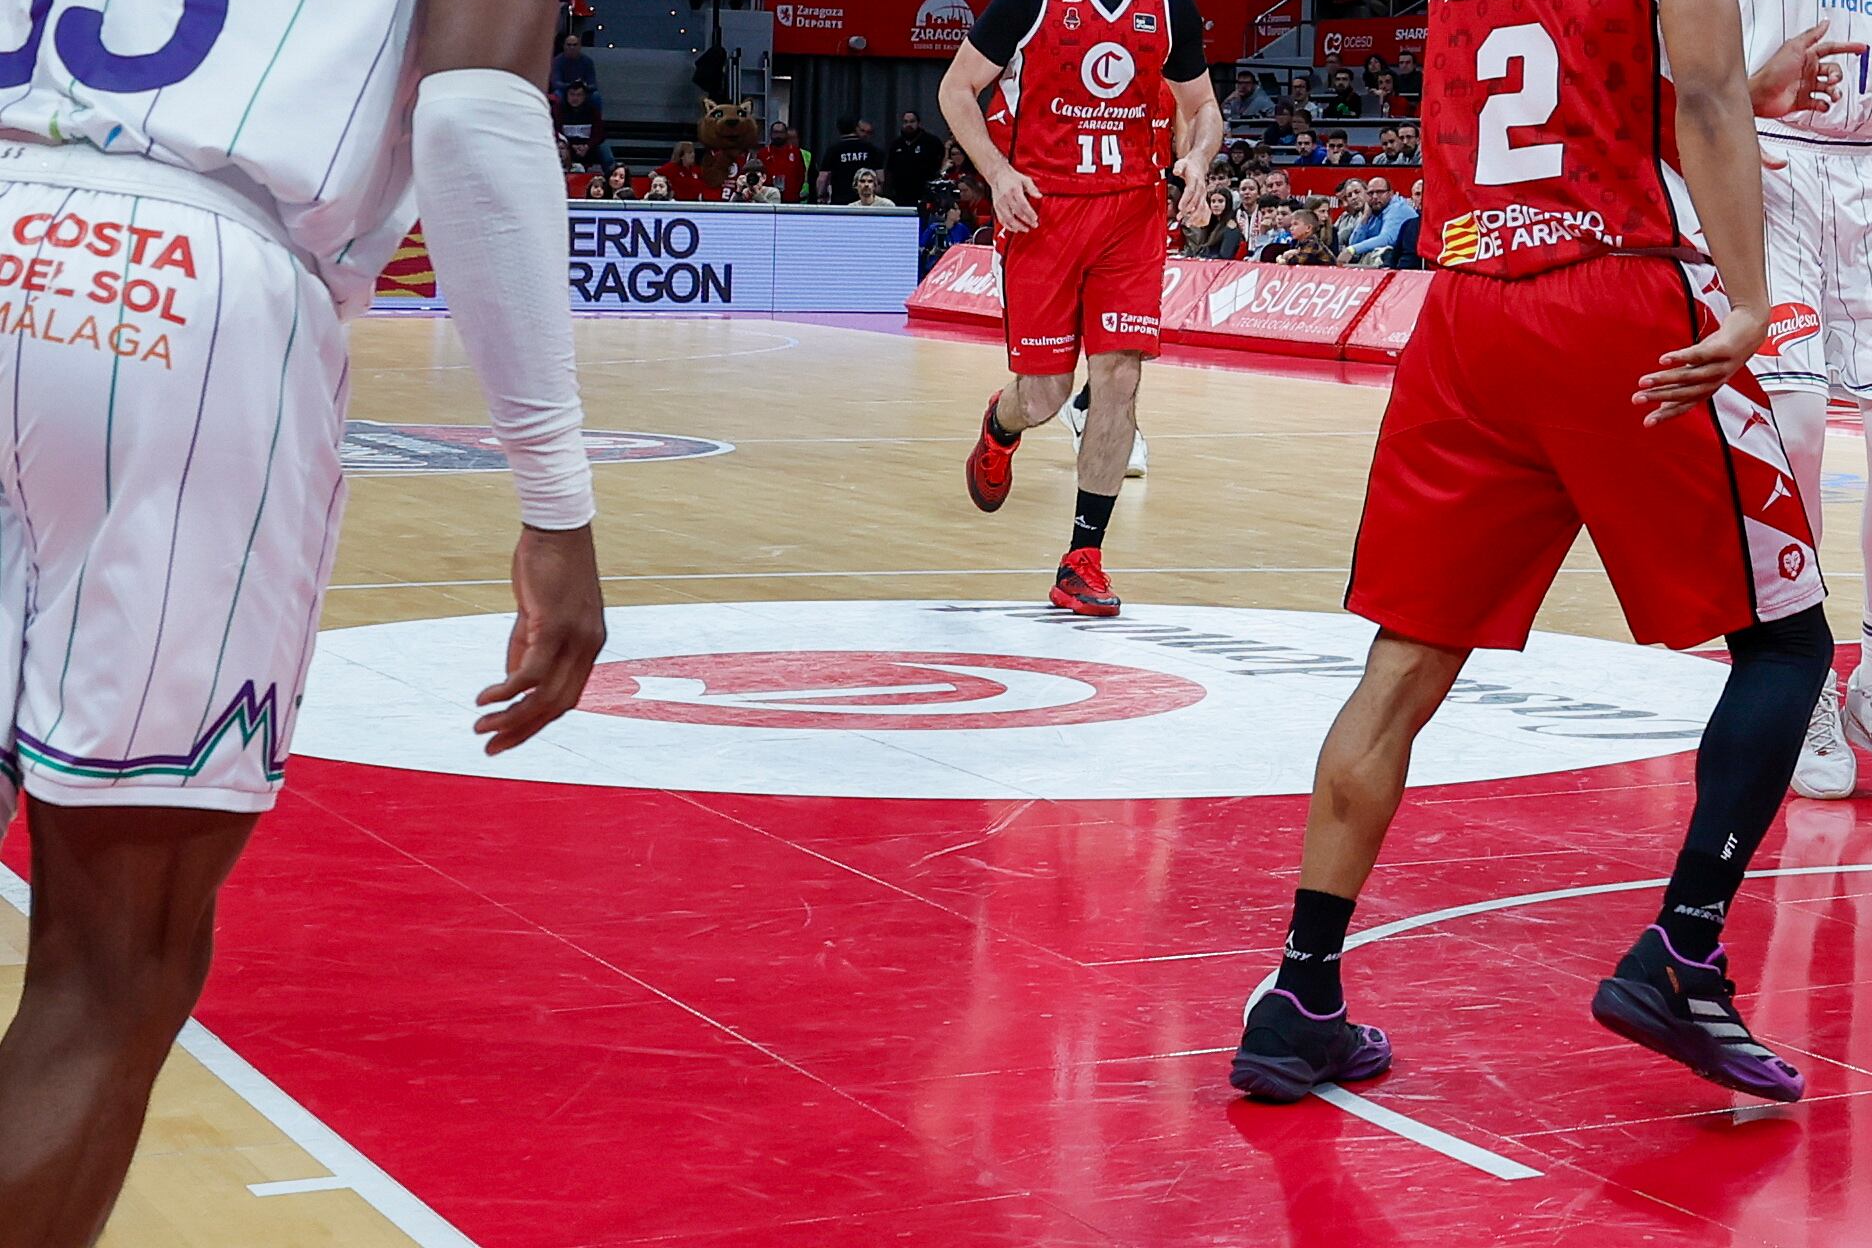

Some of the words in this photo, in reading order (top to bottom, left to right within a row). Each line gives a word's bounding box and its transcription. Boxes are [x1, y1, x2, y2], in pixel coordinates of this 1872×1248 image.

[797, 5, 844, 19] Zaragoza
[1474, 23, 1563, 185] 2
[841, 152, 868, 163] STAFF
[1076, 135, 1122, 174] 14
[12, 213, 198, 280] COSTA
[1479, 232, 1504, 260] DE
[88, 270, 187, 326] SOL
[1250, 279, 1373, 320] SUGRAF
